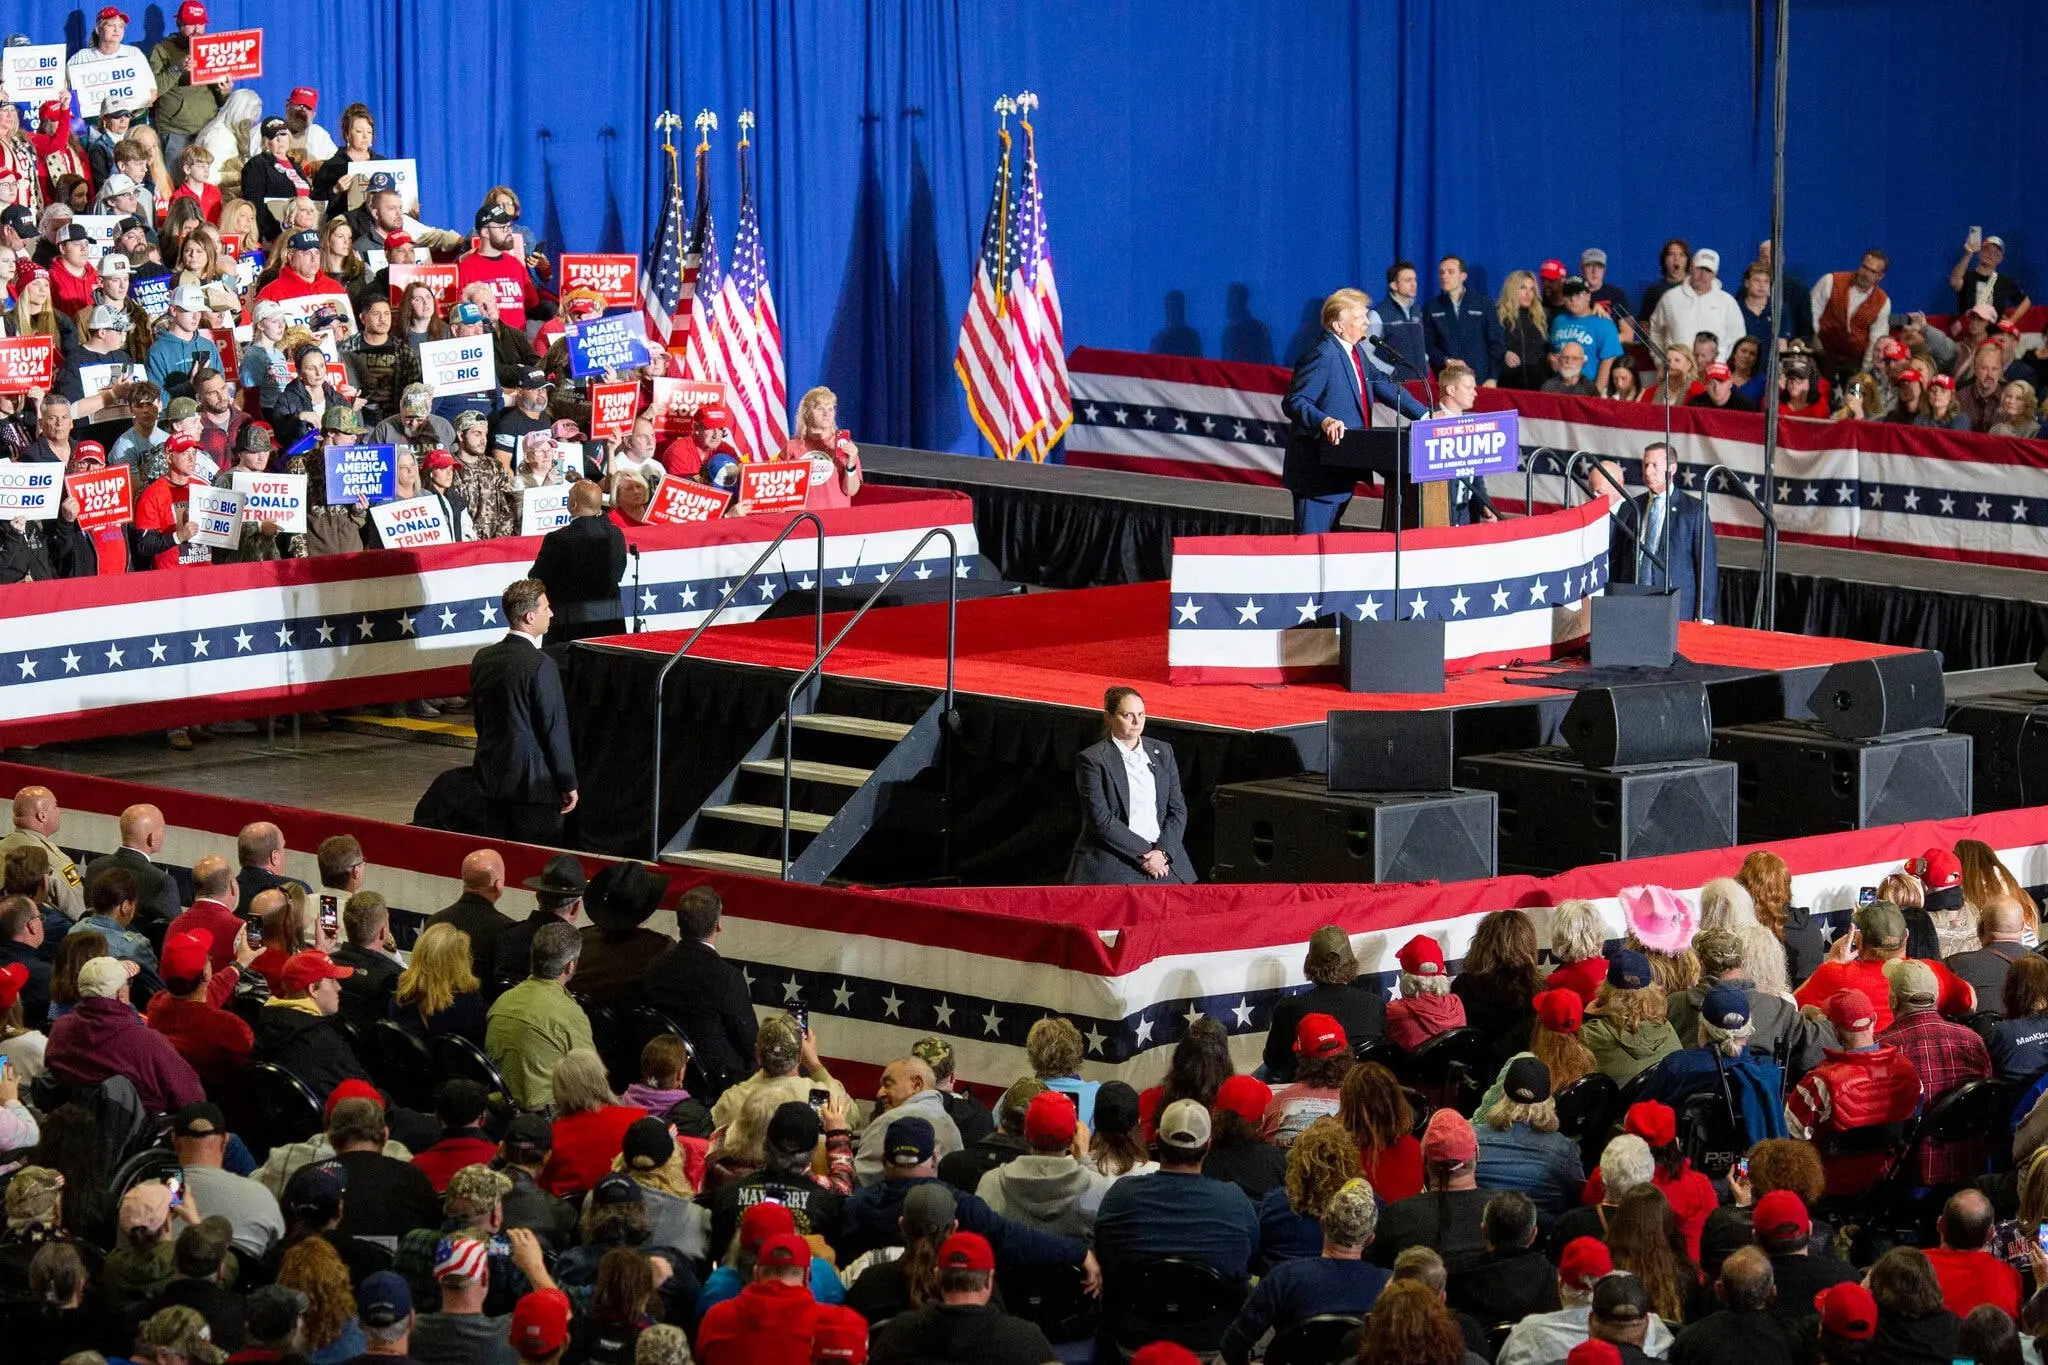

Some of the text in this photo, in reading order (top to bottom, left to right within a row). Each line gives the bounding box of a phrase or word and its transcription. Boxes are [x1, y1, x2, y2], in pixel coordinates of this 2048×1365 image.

[198, 39, 256, 57] TRUMP
[12, 57, 57, 70] TOO BIG
[206, 52, 247, 68] 2024
[17, 76, 54, 88] TO RIG
[83, 68, 135, 86] TOO BIG
[91, 90, 107, 104] TO
[303, 233, 320, 243] USA
[568, 264, 632, 278] TRUMP
[587, 320, 624, 337] MAKE
[579, 329, 636, 350] AMERICA
[0, 347, 49, 363] TRUMP
[431, 347, 483, 365] TOO BIG
[587, 340, 630, 361] GREAT
[588, 351, 633, 369] AGAIN!
[8, 361, 45, 377] 2024
[437, 367, 479, 383] TO RIG
[597, 391, 635, 409] TRUMP
[602, 405, 630, 422] 2024
[670, 404, 698, 417] 202
[1425, 431, 1506, 461] TRUMP
[344, 450, 379, 462] MAKE
[335, 461, 388, 473] AMERICA
[29, 475, 52, 486] BIG
[343, 472, 382, 484] GREAT
[748, 469, 806, 487] TRUMP
[74, 477, 126, 498] TRUMP
[252, 482, 289, 495] VOTE
[342, 484, 382, 496] AGAIN!
[754, 482, 796, 499] 2024
[0, 494, 45, 506] TO RIG
[85, 492, 119, 512] 2024
[198, 498, 219, 511] TOO
[220, 501, 237, 514] BIG
[531, 497, 559, 510] TOO
[666, 486, 722, 511] TRUMP
[243, 510, 295, 521] TRUMP
[391, 506, 428, 522] VOTE
[666, 501, 709, 521] 2024
[200, 518, 230, 533] TO RIG
[385, 517, 440, 536] DONALD
[537, 516, 553, 527] TO
[395, 530, 440, 548] TRUMP
